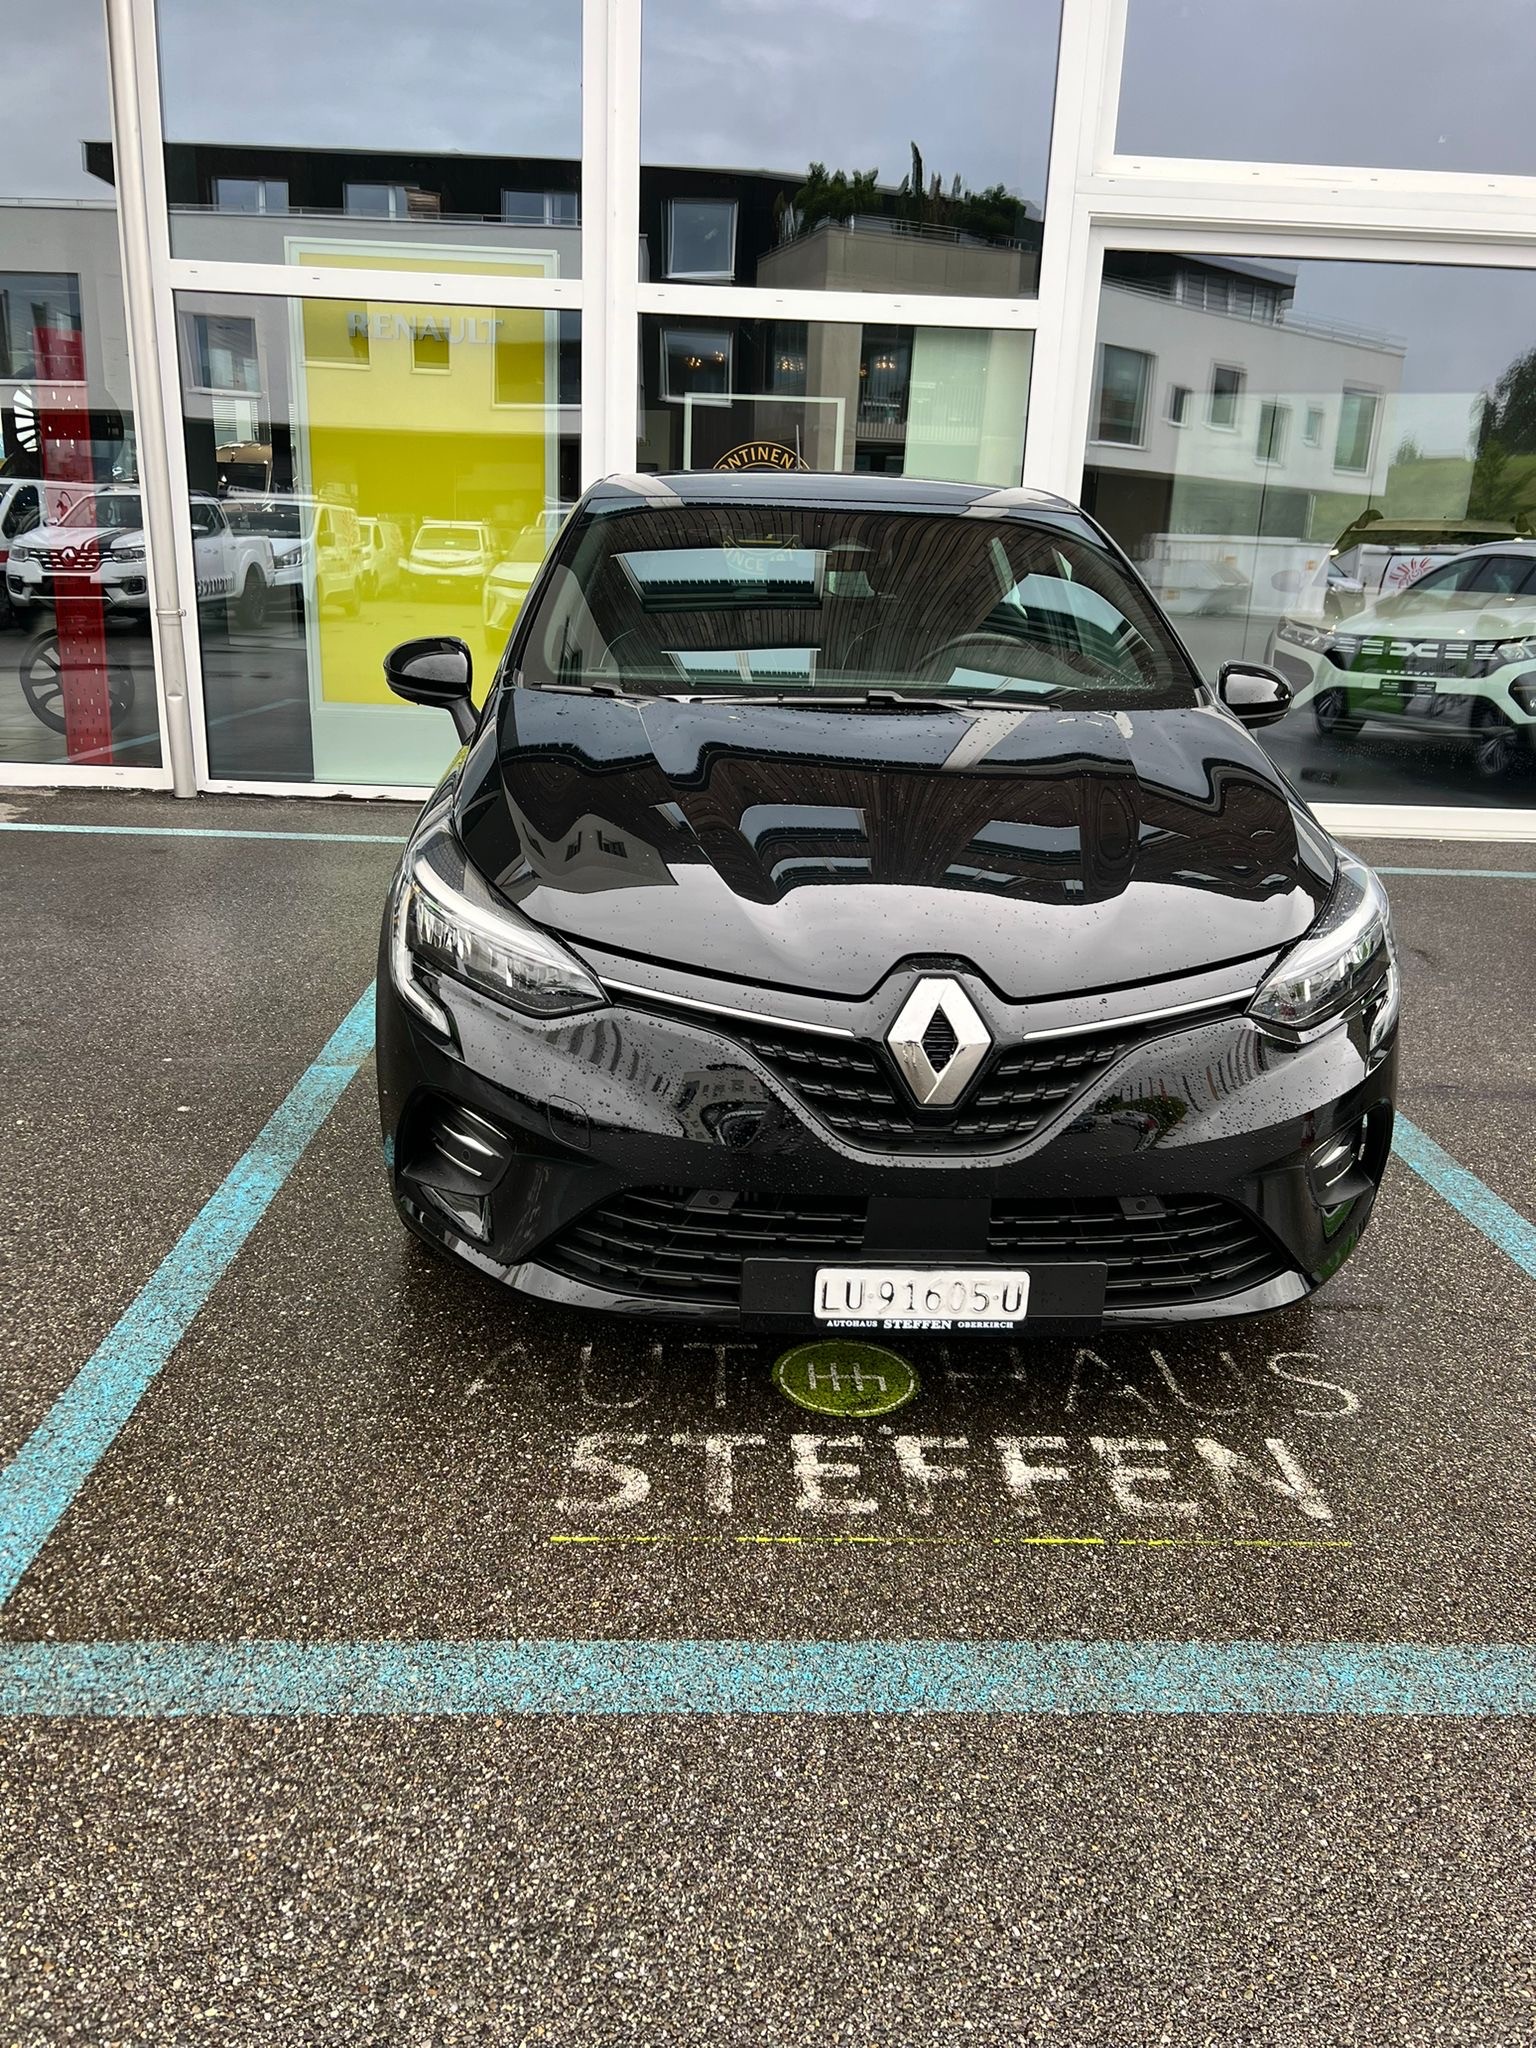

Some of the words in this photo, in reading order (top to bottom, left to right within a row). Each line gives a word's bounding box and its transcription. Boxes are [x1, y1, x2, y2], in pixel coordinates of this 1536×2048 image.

[346, 312, 504, 345] RENAULT
[826, 1319, 878, 1329] AUTOHAUS
[883, 1319, 952, 1330] STEFFEN
[957, 1321, 1014, 1329] OBERKIRCH
[554, 1433, 1335, 1520] STEFFEN
